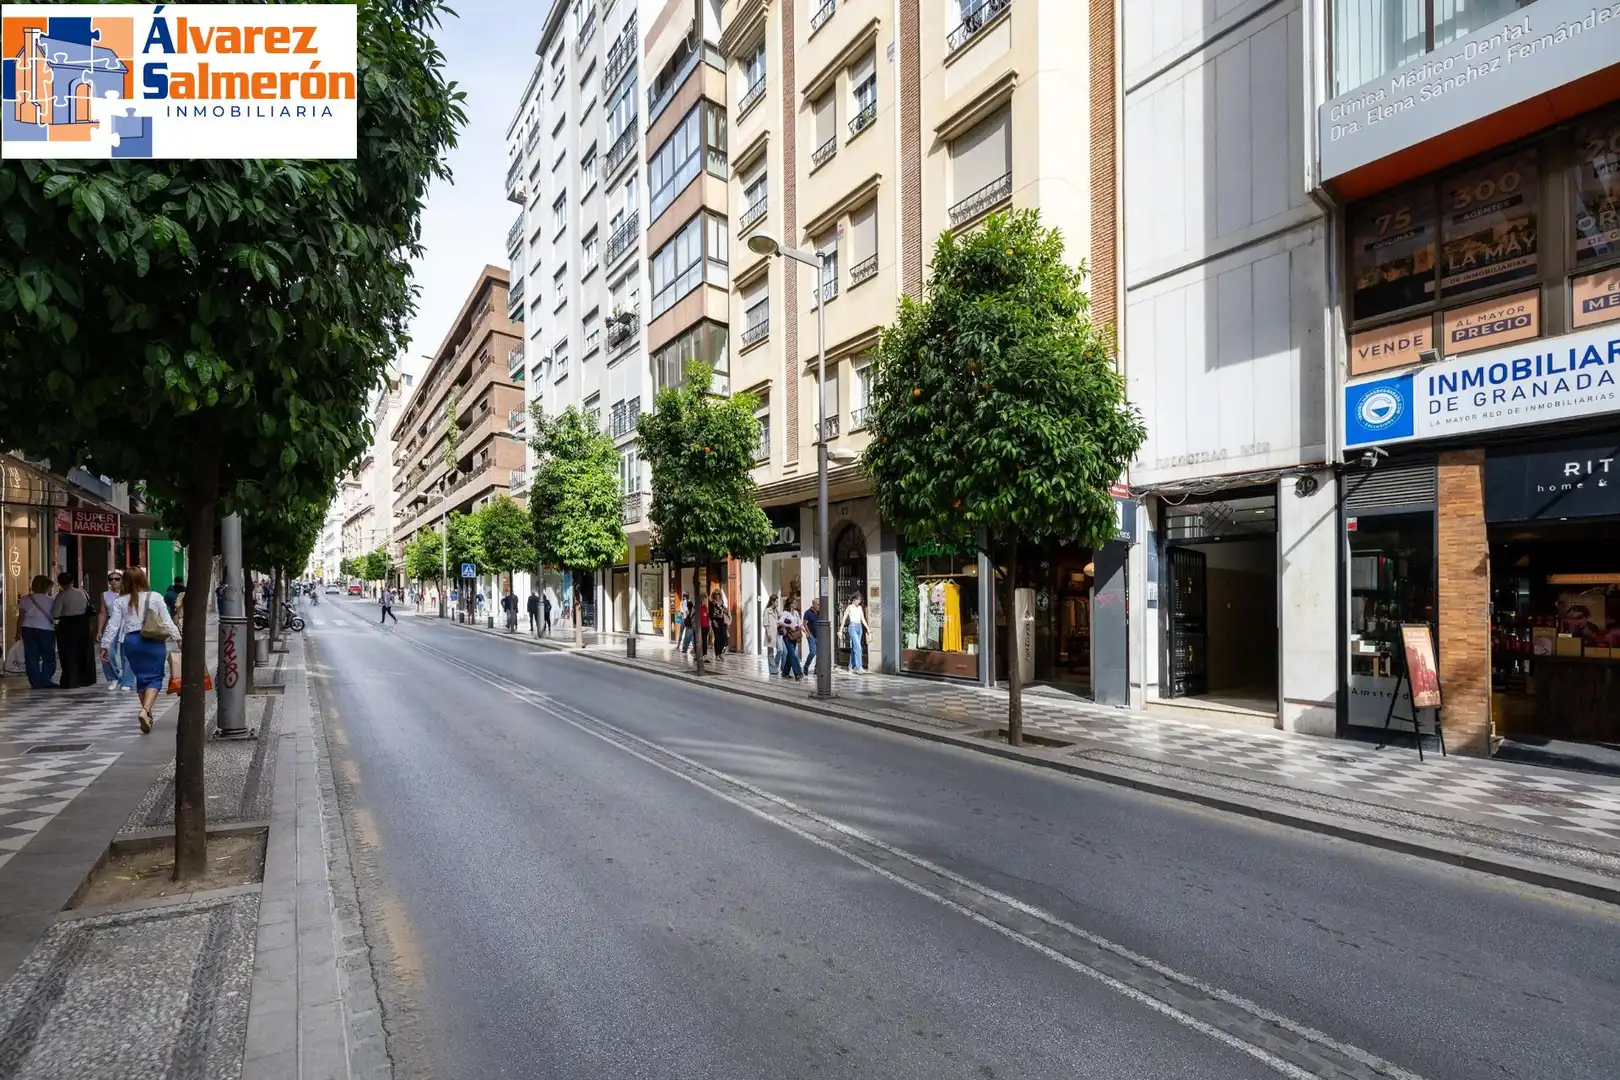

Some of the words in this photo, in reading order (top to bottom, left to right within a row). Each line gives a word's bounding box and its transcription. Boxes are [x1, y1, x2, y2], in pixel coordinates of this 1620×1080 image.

[1330, 87, 1386, 122] Clínica
[1391, 15, 1532, 95] Médico-Dental
[1330, 120, 1363, 142] Dra.
[1367, 93, 1415, 126] Elena
[1420, 56, 1501, 103] Sánchez
[1507, 2, 1620, 65] Fernández
[1451, 171, 1522, 210] 300
[1372, 207, 1413, 238] 75
[1463, 199, 1512, 221] AGENTES
[1449, 253, 1477, 271] LA
[1450, 277, 1461, 285] DE
[1463, 259, 1528, 281] INMOBILIARIAS
[1608, 282, 1620, 292] E
[1455, 315, 1529, 342] PRECIO
[1456, 319, 1472, 328] AL
[1477, 305, 1526, 324] MAYOR
[1358, 334, 1424, 359] VENDE
[1429, 339, 1620, 397] INMOBILIAR
[1429, 396, 1459, 415] DE
[1474, 369, 1615, 408] GRANADA
[1429, 420, 1441, 428] LA
[1446, 414, 1478, 426] MAYOR
[1483, 410, 1502, 419] RED
[1507, 407, 1520, 415] DE
[1525, 392, 1615, 412] INMOBILIARIAS
[1563, 457, 1614, 477] RIT
[1301, 479, 1315, 492] 19
[1537, 482, 1584, 493] home
[1598, 478, 1608, 488] &
[74, 521, 117, 533] MARKET
[75, 511, 115, 523] SUPER
